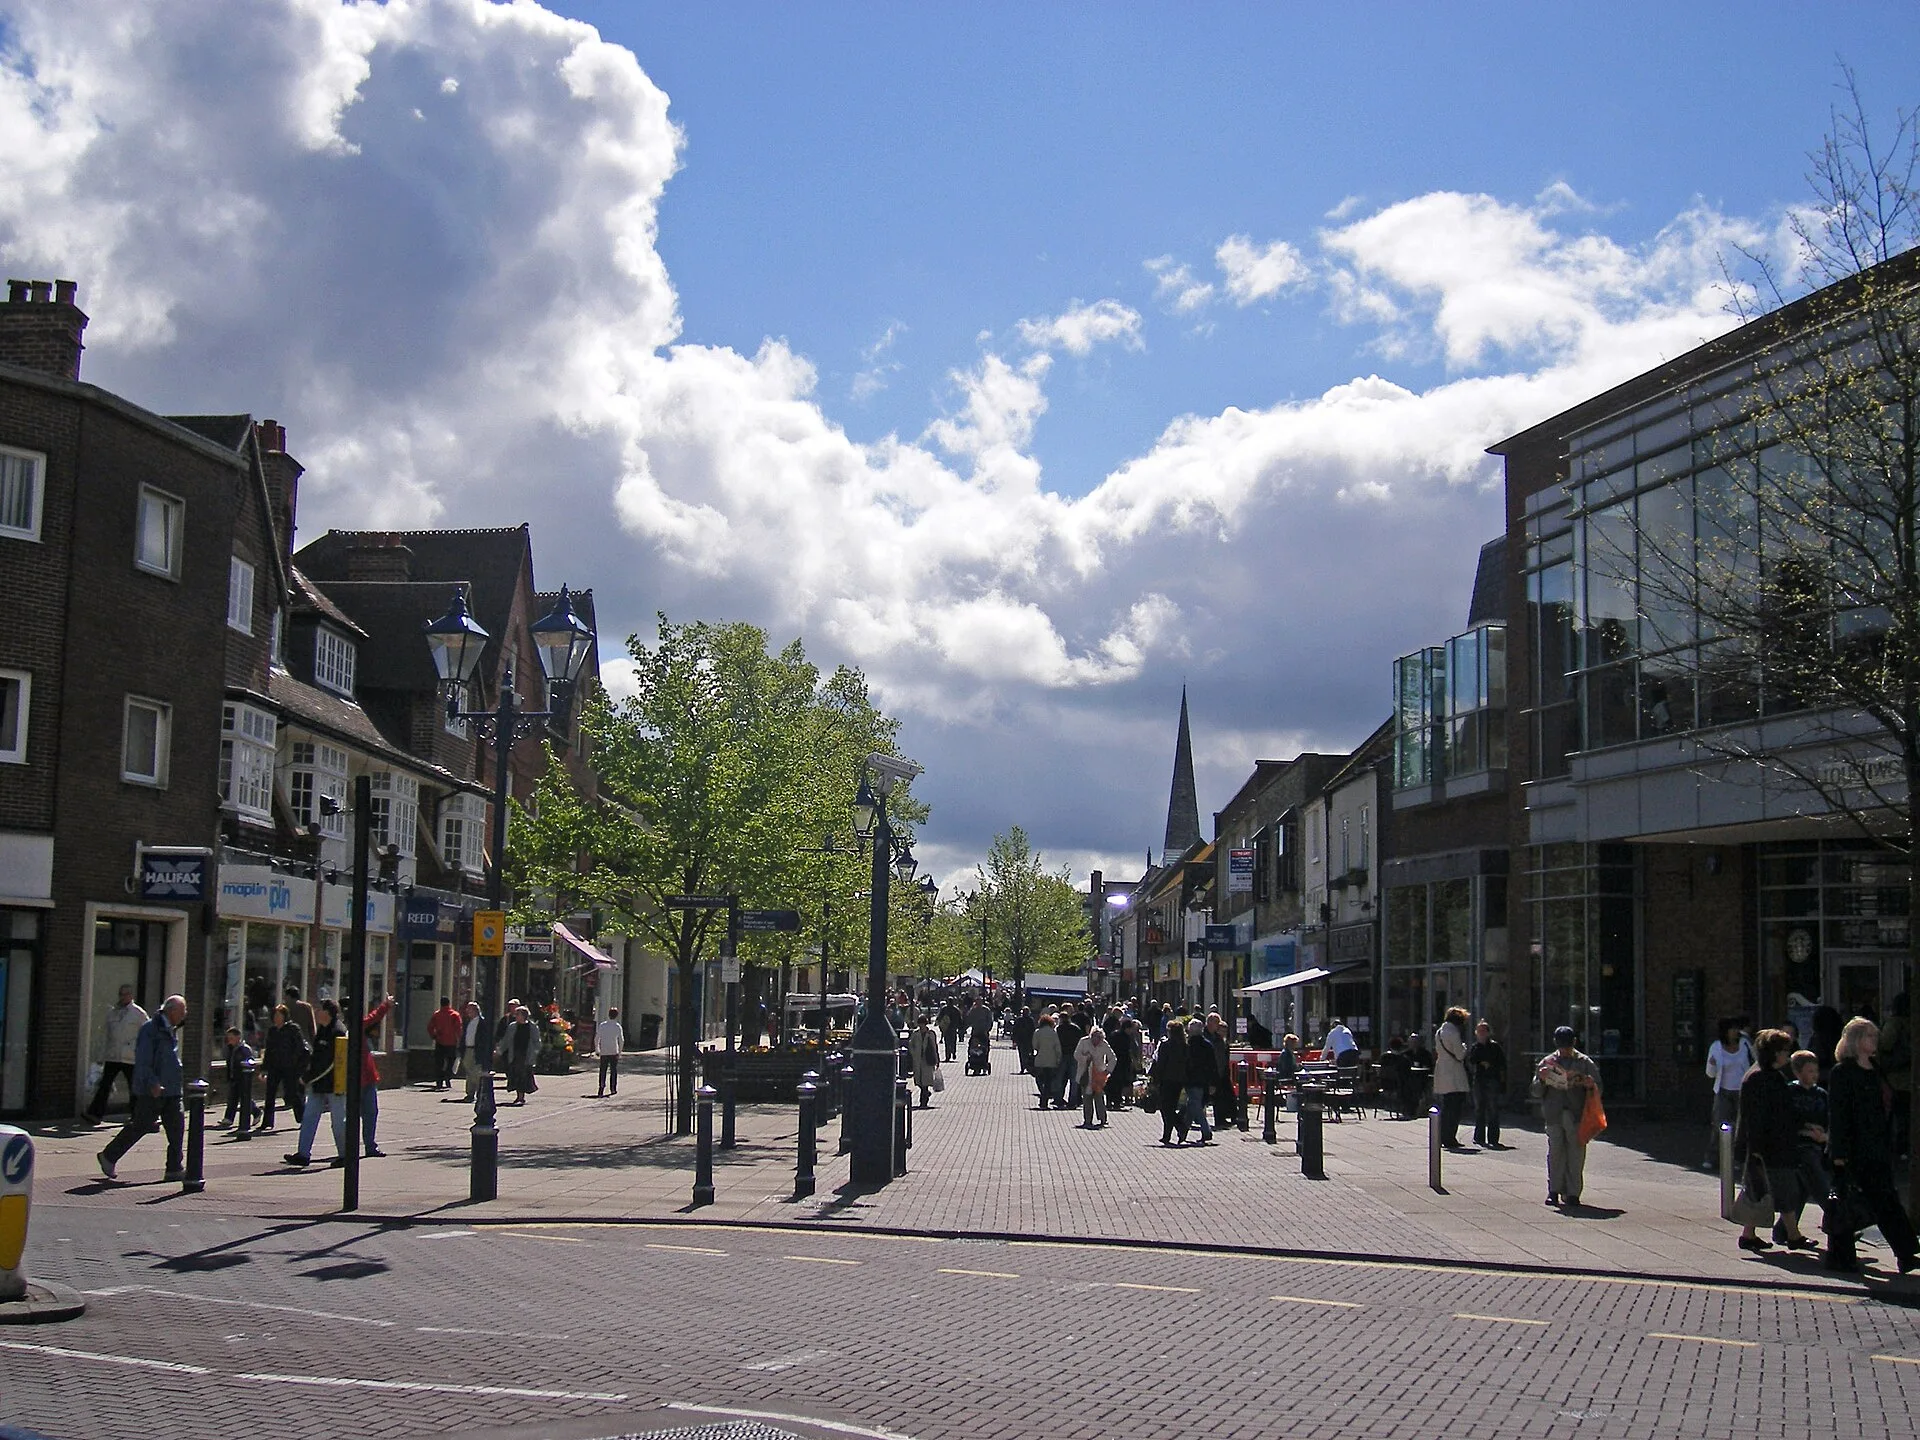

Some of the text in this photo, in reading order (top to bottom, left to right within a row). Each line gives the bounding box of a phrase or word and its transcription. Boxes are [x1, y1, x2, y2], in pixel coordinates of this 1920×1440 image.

[145, 871, 201, 884] HALIFAX
[223, 881, 267, 897] maplin
[407, 913, 435, 924] REED
